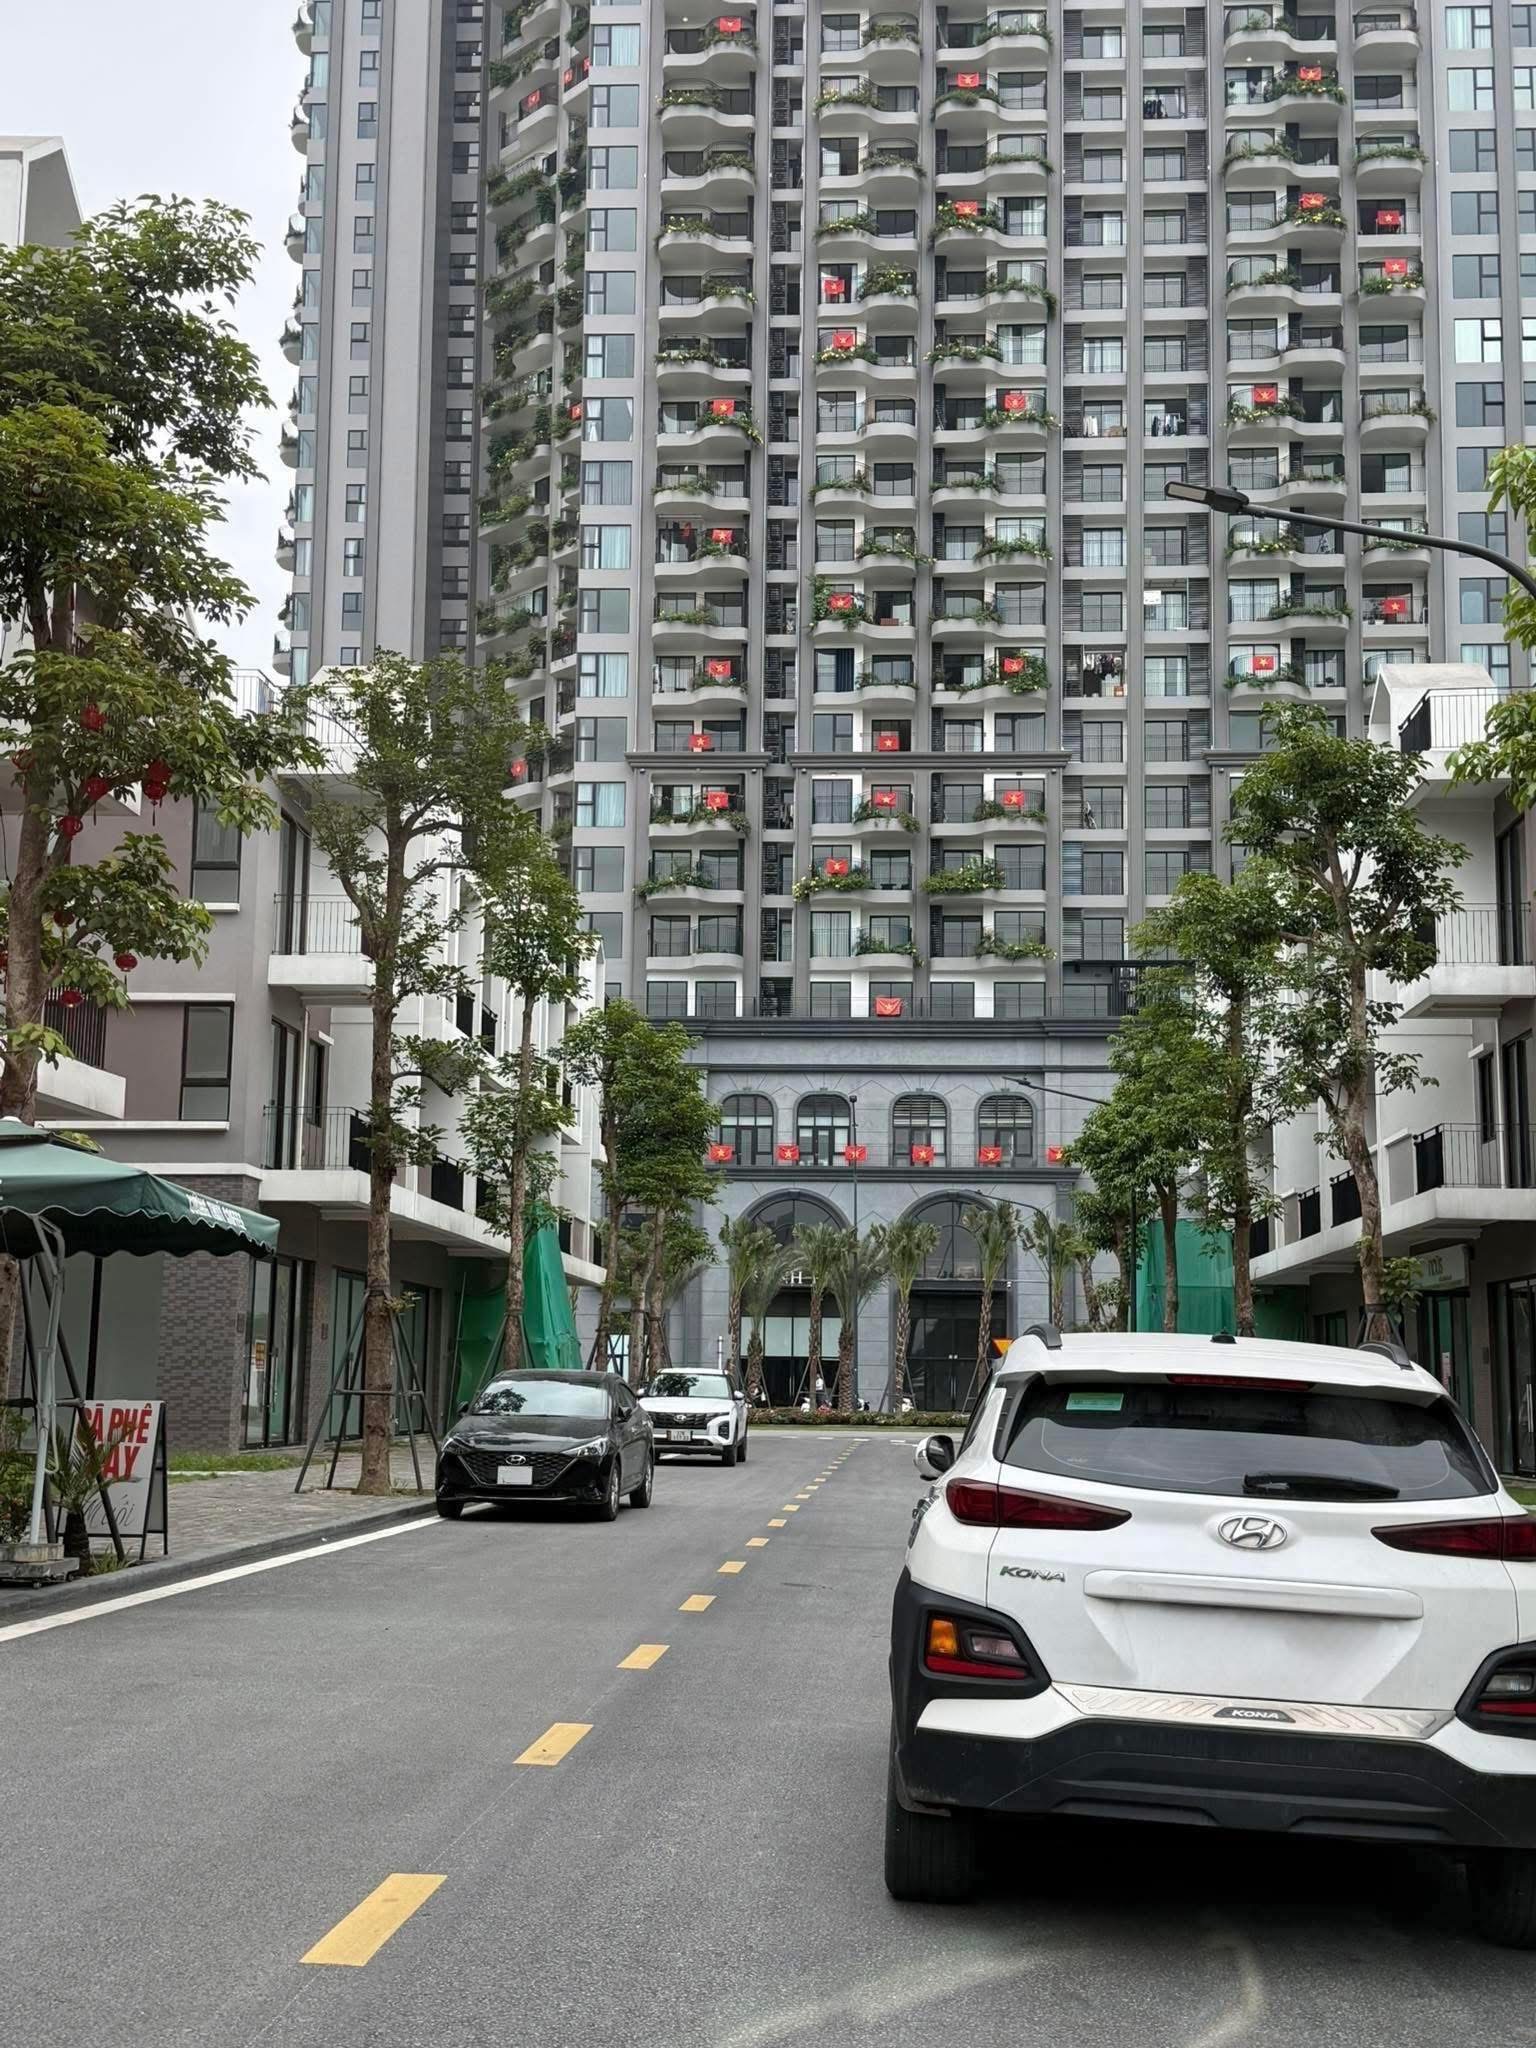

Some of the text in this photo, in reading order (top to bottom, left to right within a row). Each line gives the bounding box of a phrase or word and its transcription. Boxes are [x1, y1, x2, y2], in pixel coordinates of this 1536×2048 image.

[107, 1403, 152, 1443] PHÊ
[1000, 1566, 1065, 1582] KONA
[1231, 1709, 1279, 1720] KONA
